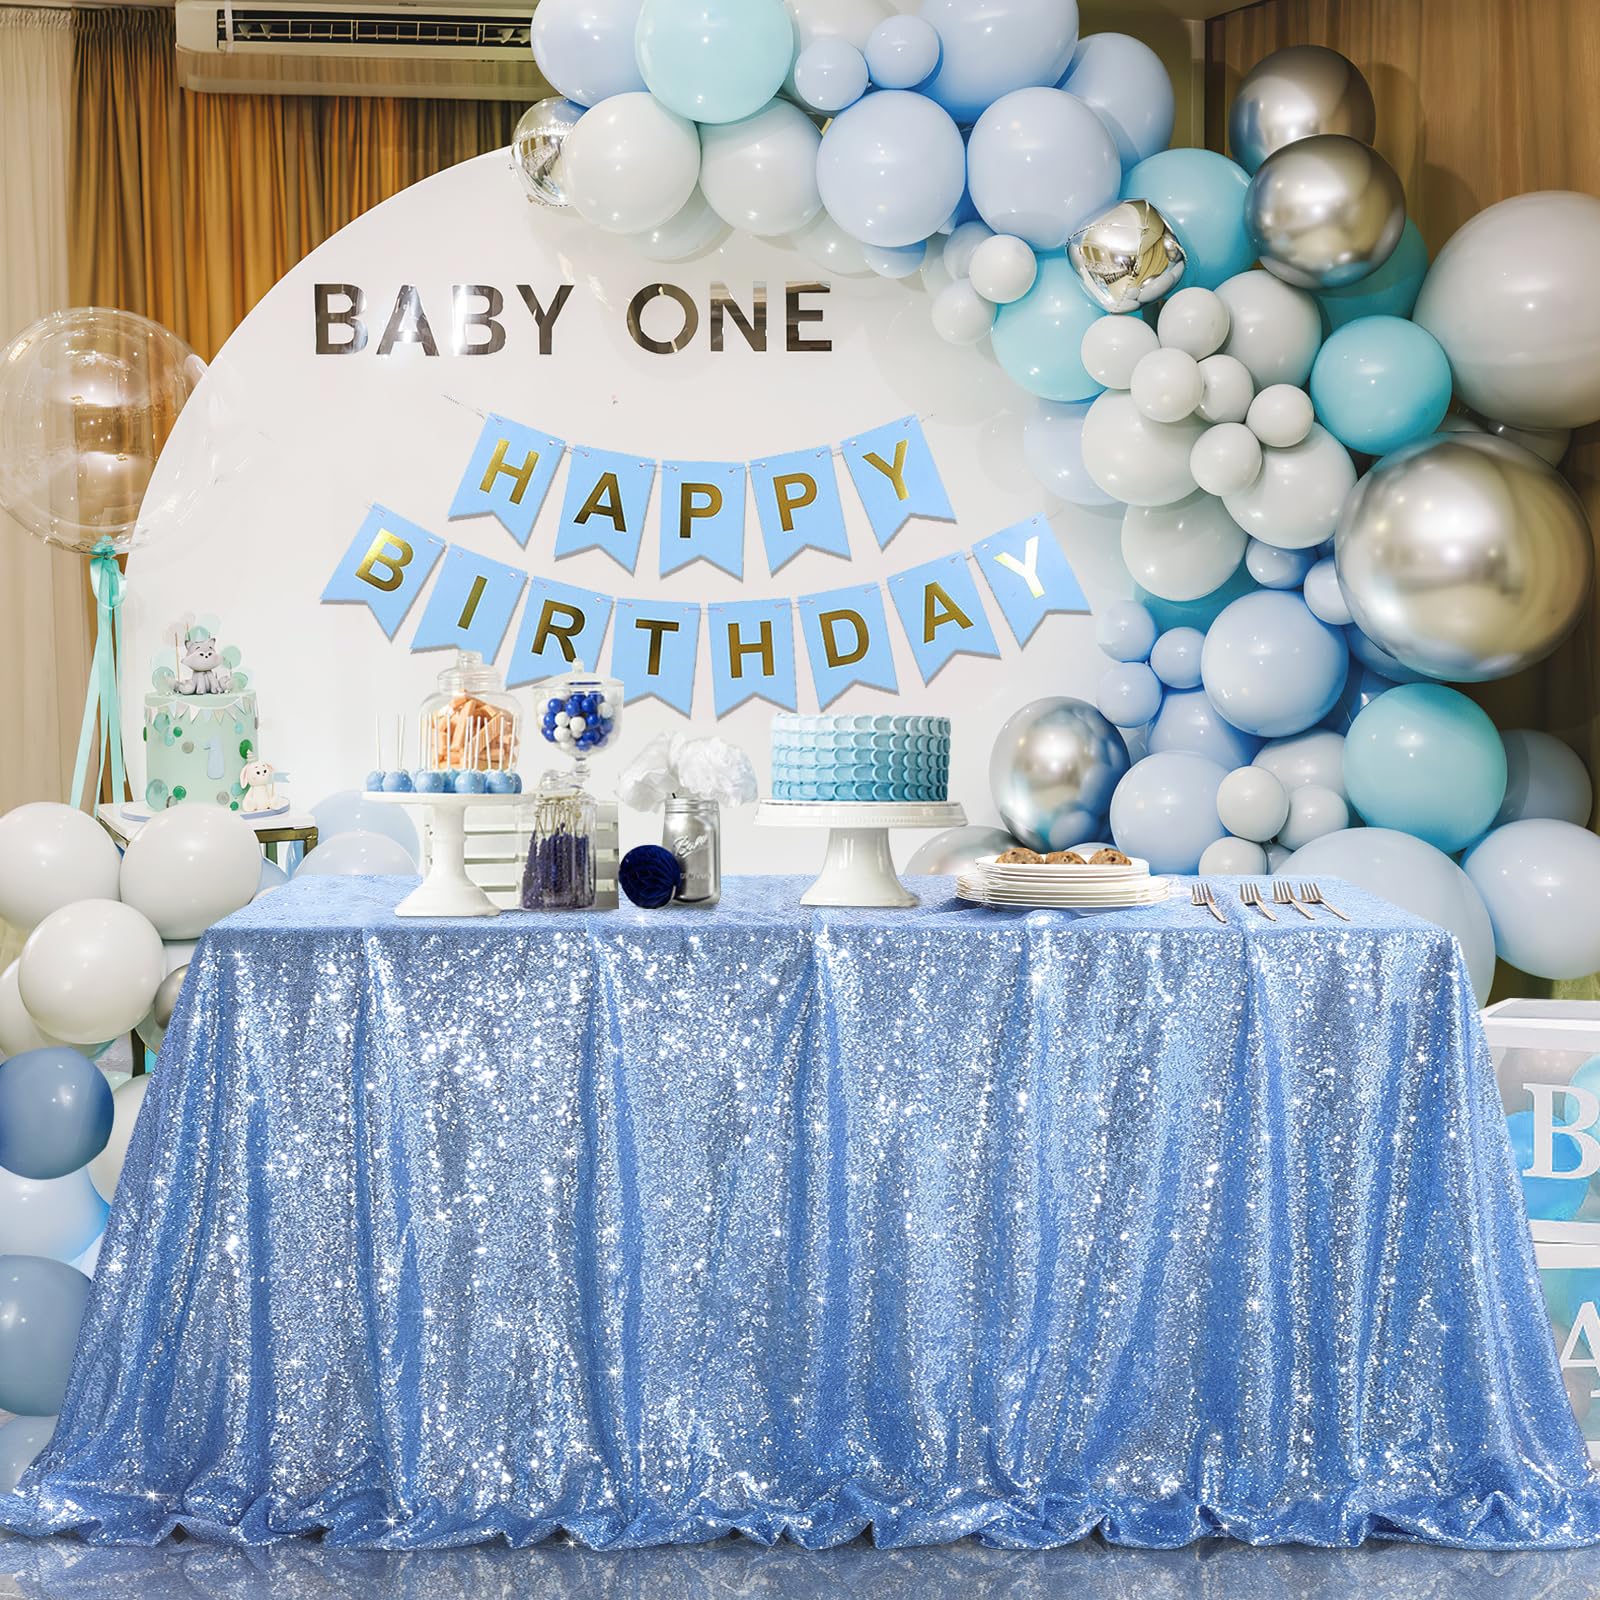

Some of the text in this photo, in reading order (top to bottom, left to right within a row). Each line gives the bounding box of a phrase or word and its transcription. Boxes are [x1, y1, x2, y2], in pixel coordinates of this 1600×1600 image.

[314, 280, 833, 356] BABY ONE
[479, 438, 910, 539] HAPPY
[355, 527, 1046, 679] BIRTHDAY
[1522, 1083, 1600, 1179] B
